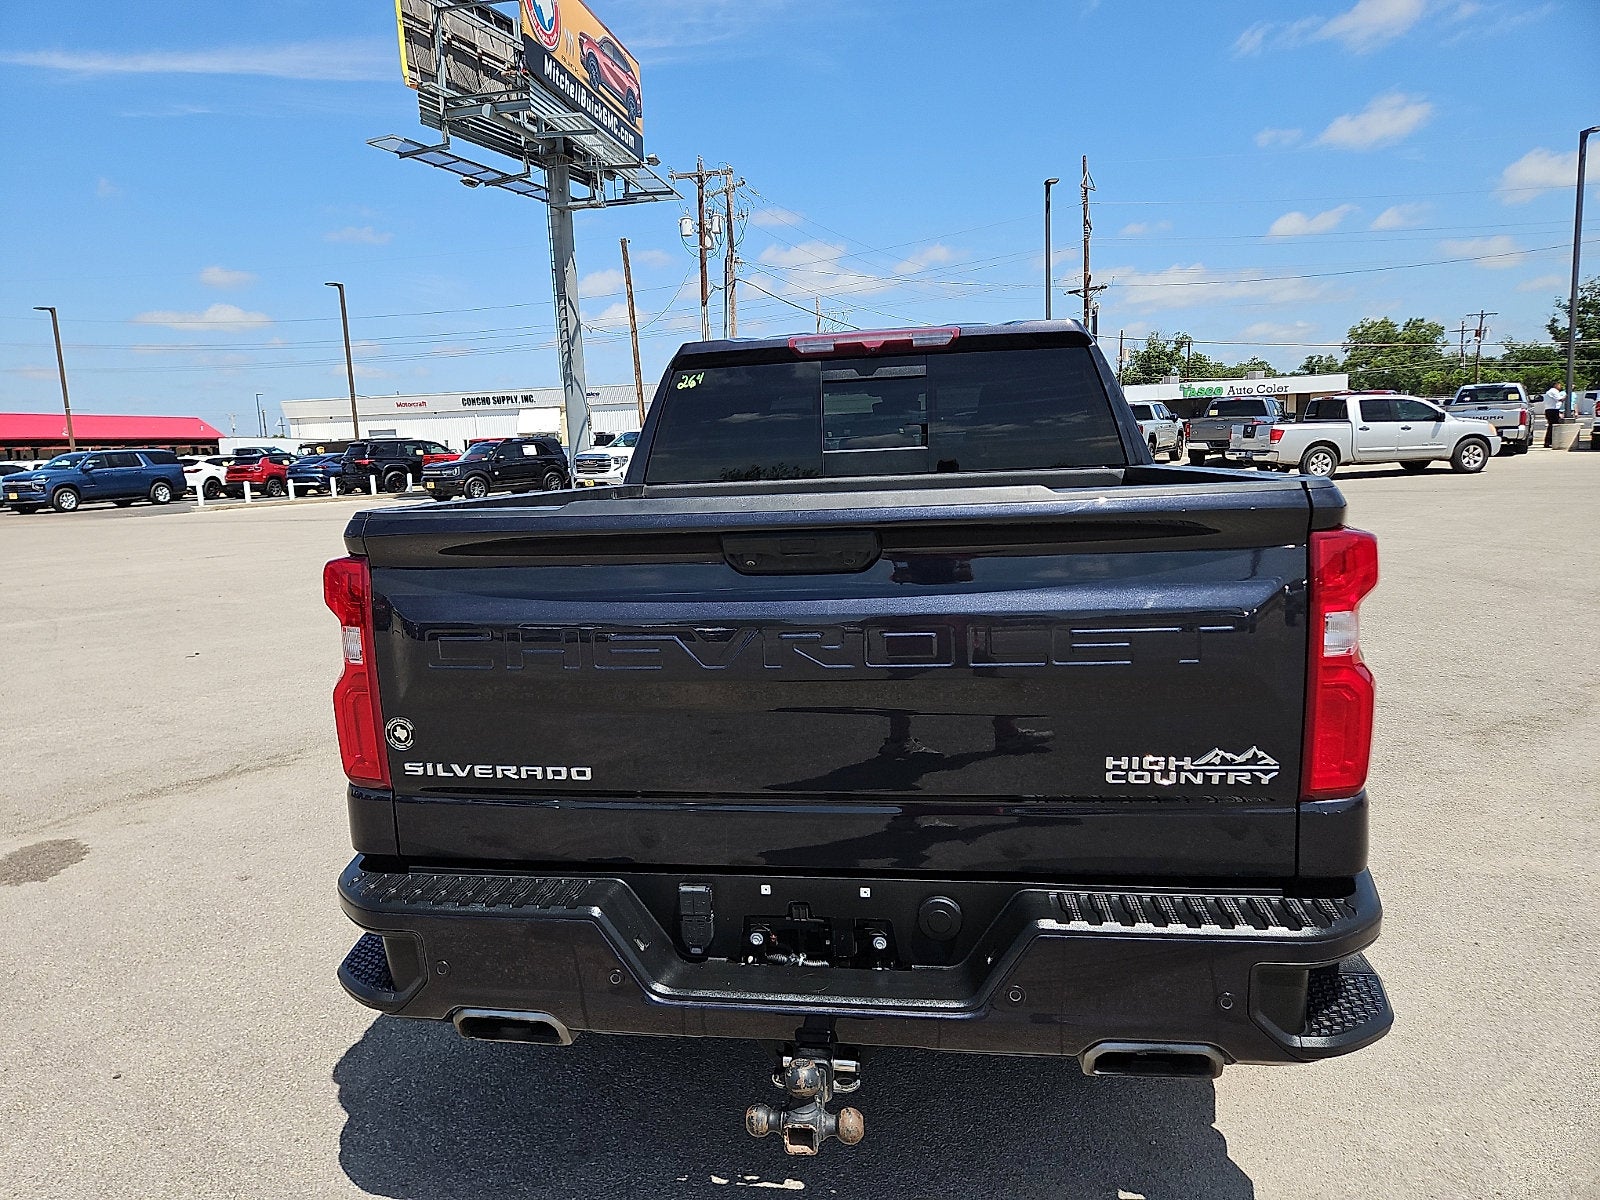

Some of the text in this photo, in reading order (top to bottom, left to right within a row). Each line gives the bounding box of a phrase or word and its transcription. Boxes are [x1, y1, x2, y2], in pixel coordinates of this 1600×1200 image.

[544, 54, 635, 149] MitchellBuickGMC.com
[677, 371, 705, 390] 264
[1227, 386, 1254, 396] Auto
[1257, 384, 1290, 395] Color
[461, 396, 491, 407] CONCHO
[521, 394, 536, 404] INC.
[425, 625, 1235, 671] CHEVROLET
[1105, 755, 1192, 770] HIGH
[403, 762, 593, 781] SILVERADO
[1105, 771, 1280, 786] COUNTRY
